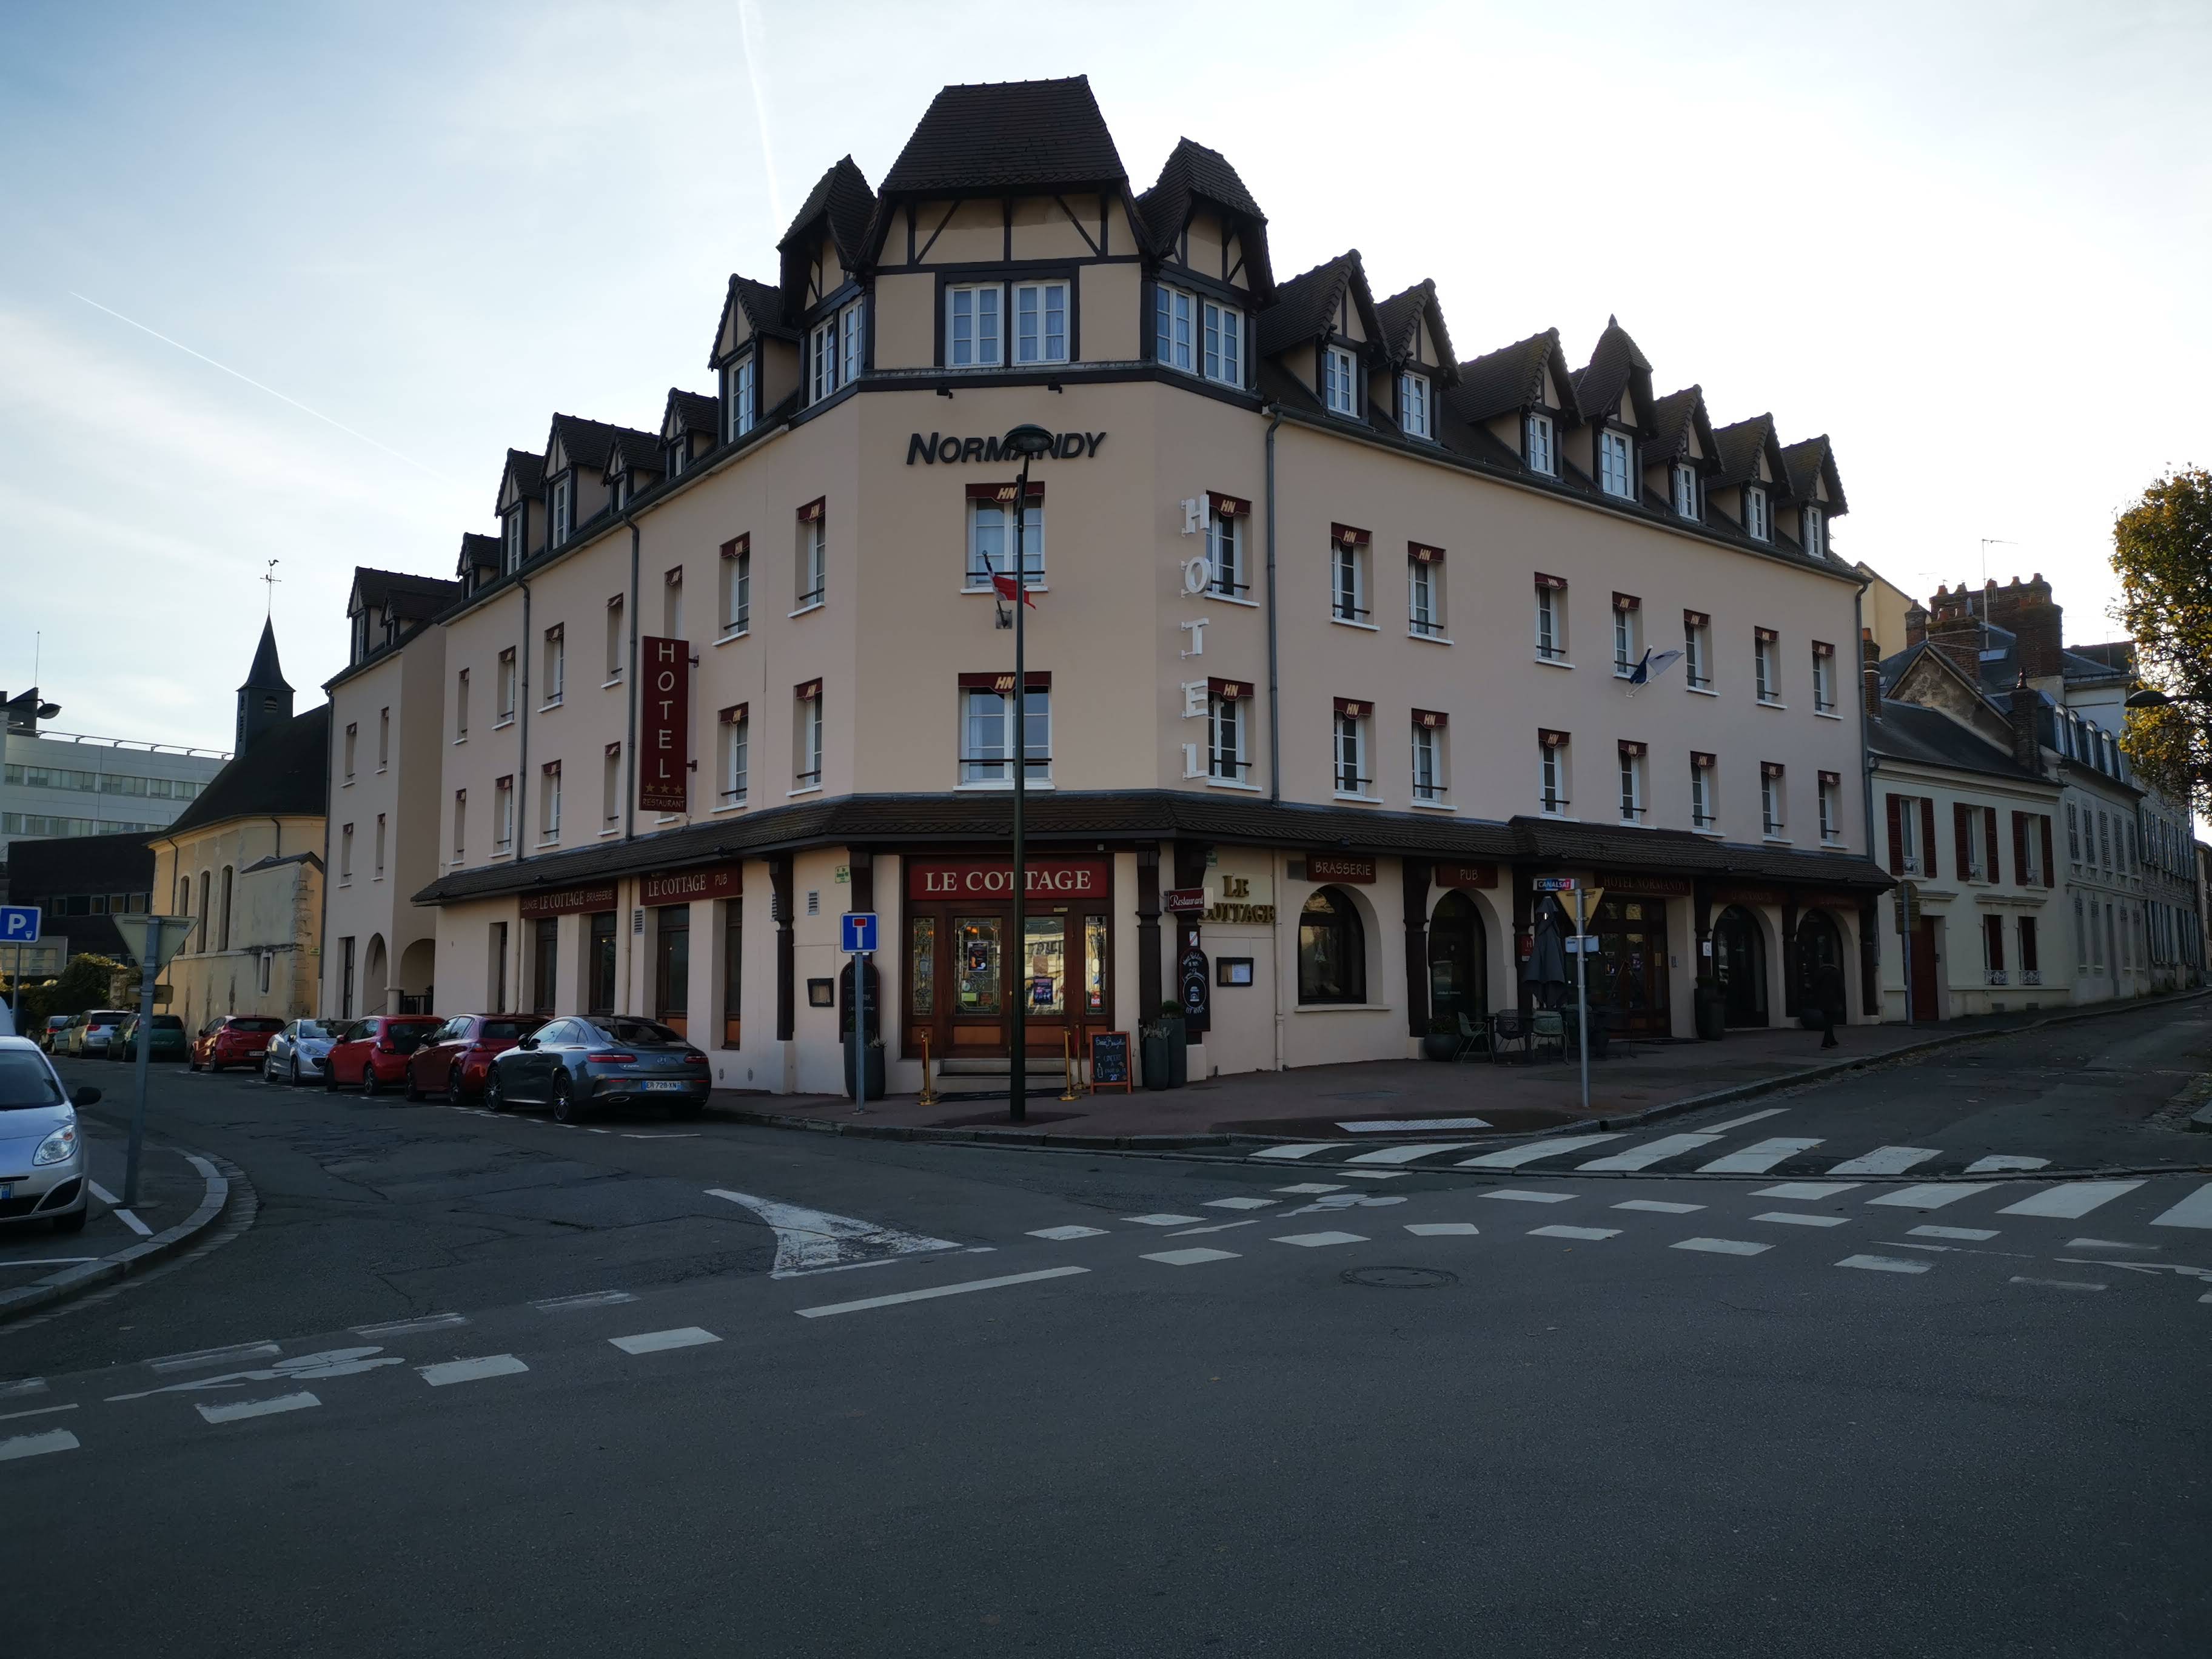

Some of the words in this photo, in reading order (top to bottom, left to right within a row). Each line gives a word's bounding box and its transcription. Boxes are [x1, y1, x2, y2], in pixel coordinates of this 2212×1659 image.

[996, 487, 1018, 500] HN
[1220, 499, 1236, 513] HN
[1343, 531, 1357, 543] HN
[1418, 548, 1432, 561] HN
[1620, 597, 1631, 609] HN
[1185, 494, 1212, 779] HOTEL
[994, 676, 1016, 689] HN
[1224, 683, 1239, 697] HN
[657, 642, 675, 779] HOTEL
[1346, 703, 1359, 716] HN
[1424, 713, 1436, 726] HN
[1547, 733, 1559, 745] HN
[1628, 744, 1638, 755] HN
[642, 798, 686, 808] RESTAURANT
[1315, 861, 1372, 876] BRASSERIE
[1460, 868, 1478, 880] PUB
[648, 881, 660, 897] LE
[661, 874, 706, 896] COTTAGE
[714, 873, 727, 886] PUB
[925, 871, 957, 891] LE
[965, 870, 1092, 891] COTTAGE
[1222, 875, 1250, 897] LE
[1538, 880, 1570, 890] CANALSAT
[539, 895, 549, 910] LE
[549, 891, 584, 908] COTTAGE
[586, 890, 612, 903] BRASSERIE
[1169, 894, 1204, 907] Restaurant
[7, 913, 27, 935] P
